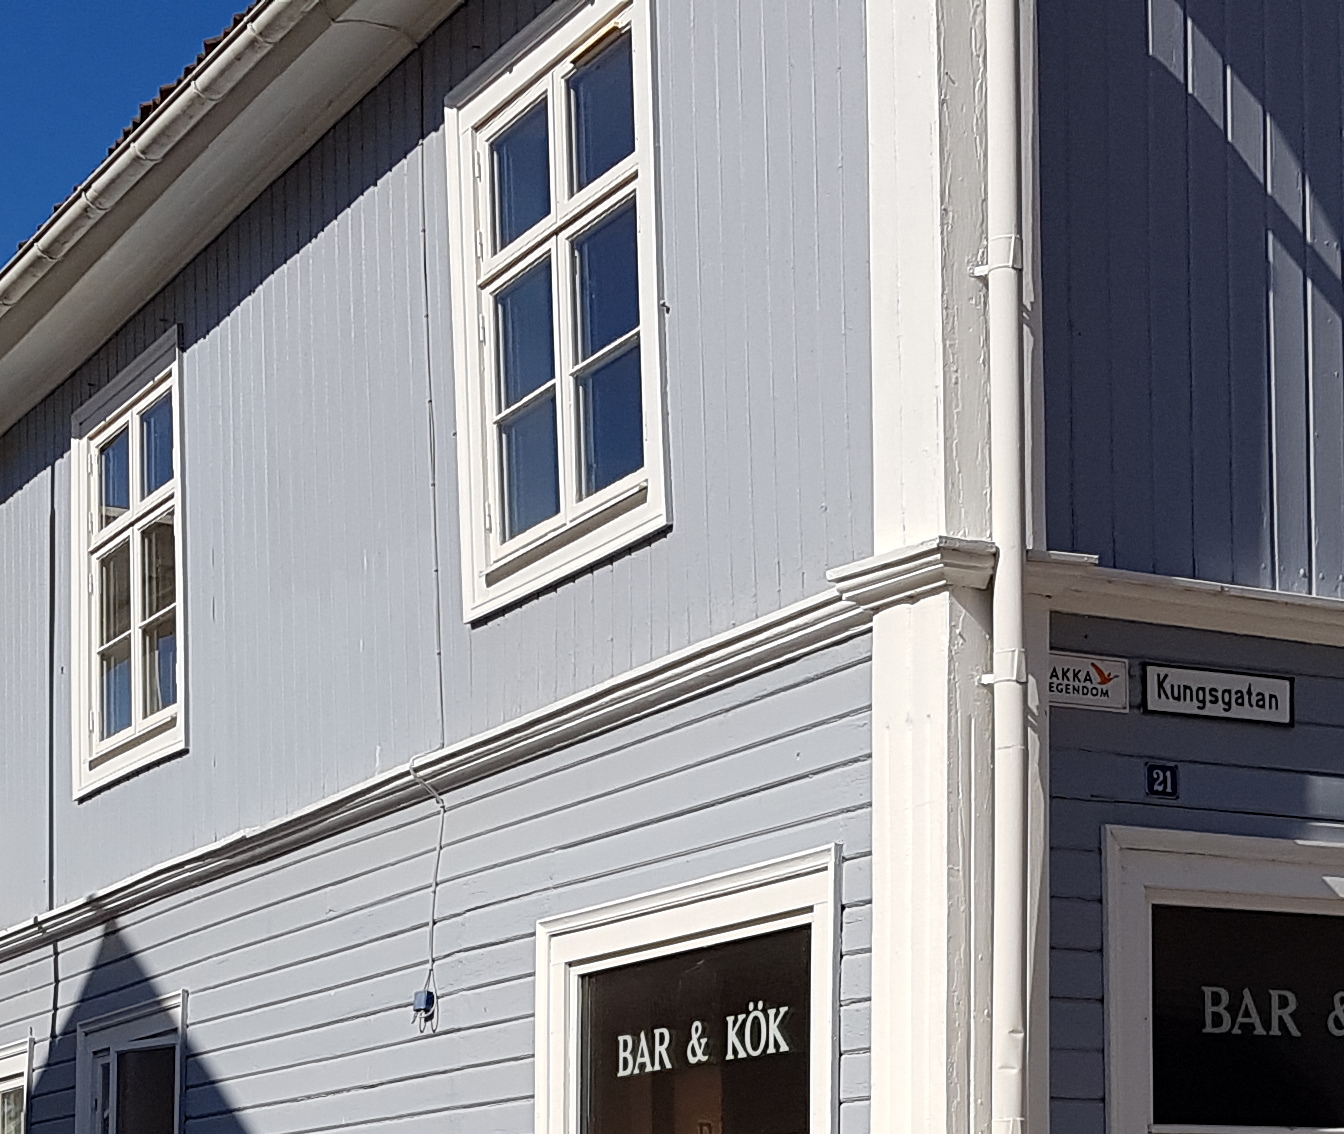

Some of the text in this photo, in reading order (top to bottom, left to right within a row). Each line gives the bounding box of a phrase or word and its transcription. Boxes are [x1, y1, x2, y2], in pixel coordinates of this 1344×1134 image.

[1049, 666, 1093, 685] AKKA
[1049, 682, 1110, 698] EGENDOM
[1156, 672, 1279, 712] Kungsgatan
[1152, 769, 1173, 793] 21
[1201, 986, 1302, 1037] BAR
[617, 1000, 790, 1078] BAR & KÖK
